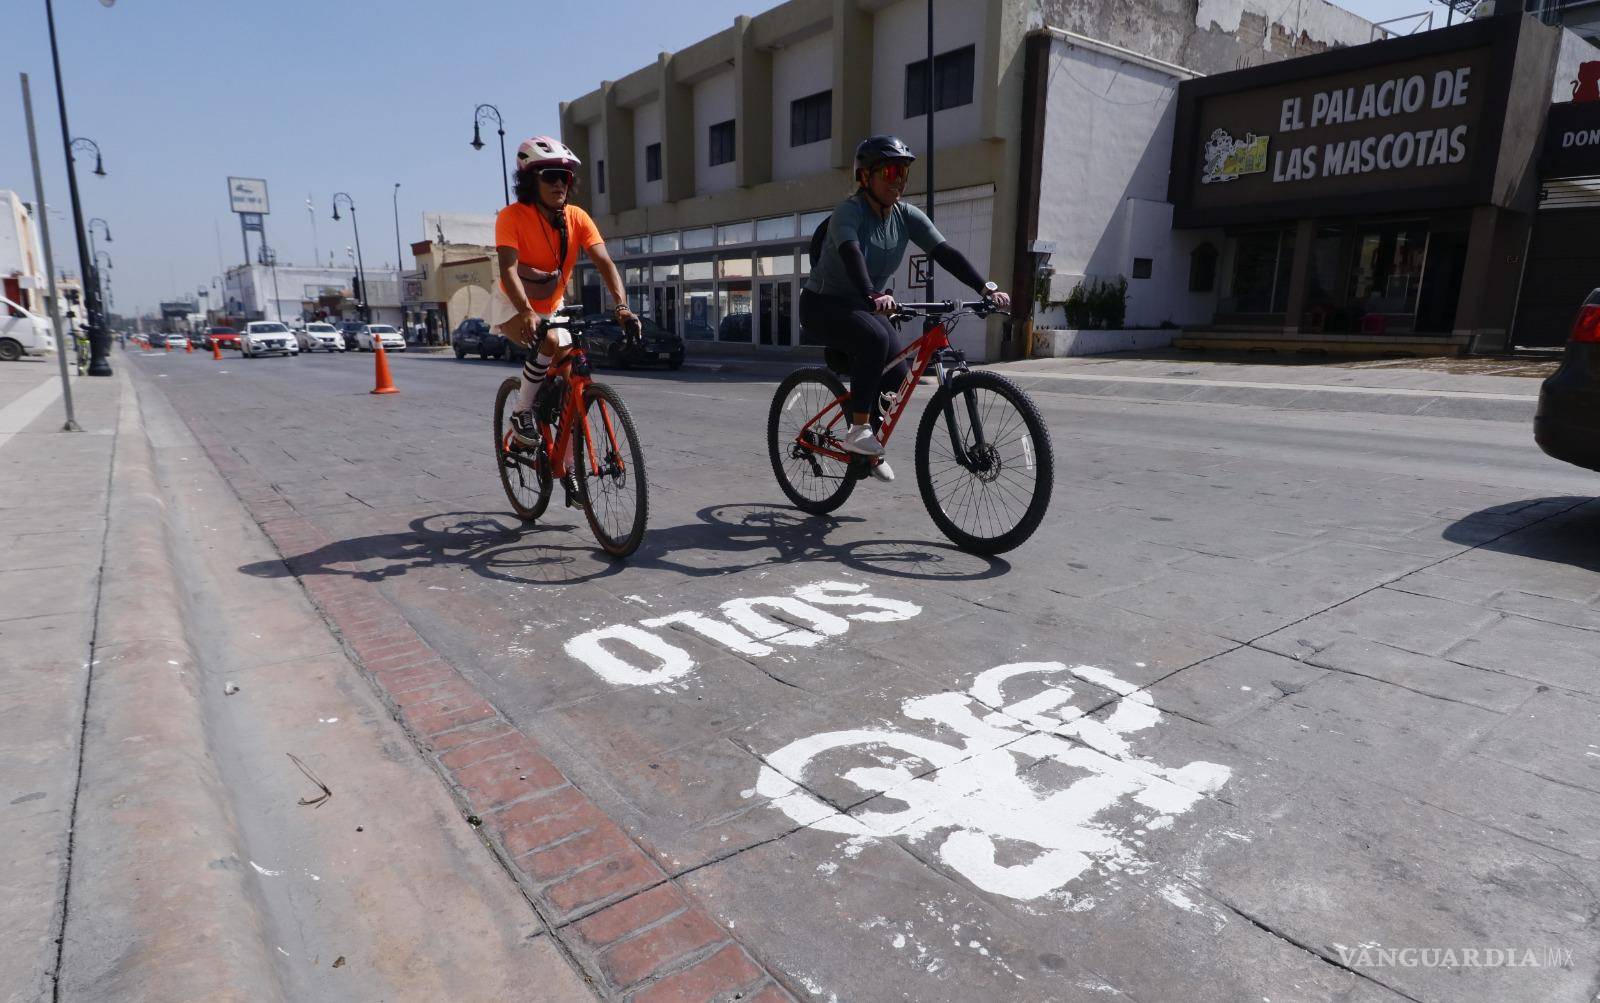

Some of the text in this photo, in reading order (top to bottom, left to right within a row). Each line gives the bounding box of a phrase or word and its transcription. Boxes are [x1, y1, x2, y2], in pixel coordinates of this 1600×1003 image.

[1279, 66, 1471, 132] EL PALACIO DE
[1273, 124, 1468, 184] LAS MASCOTAS
